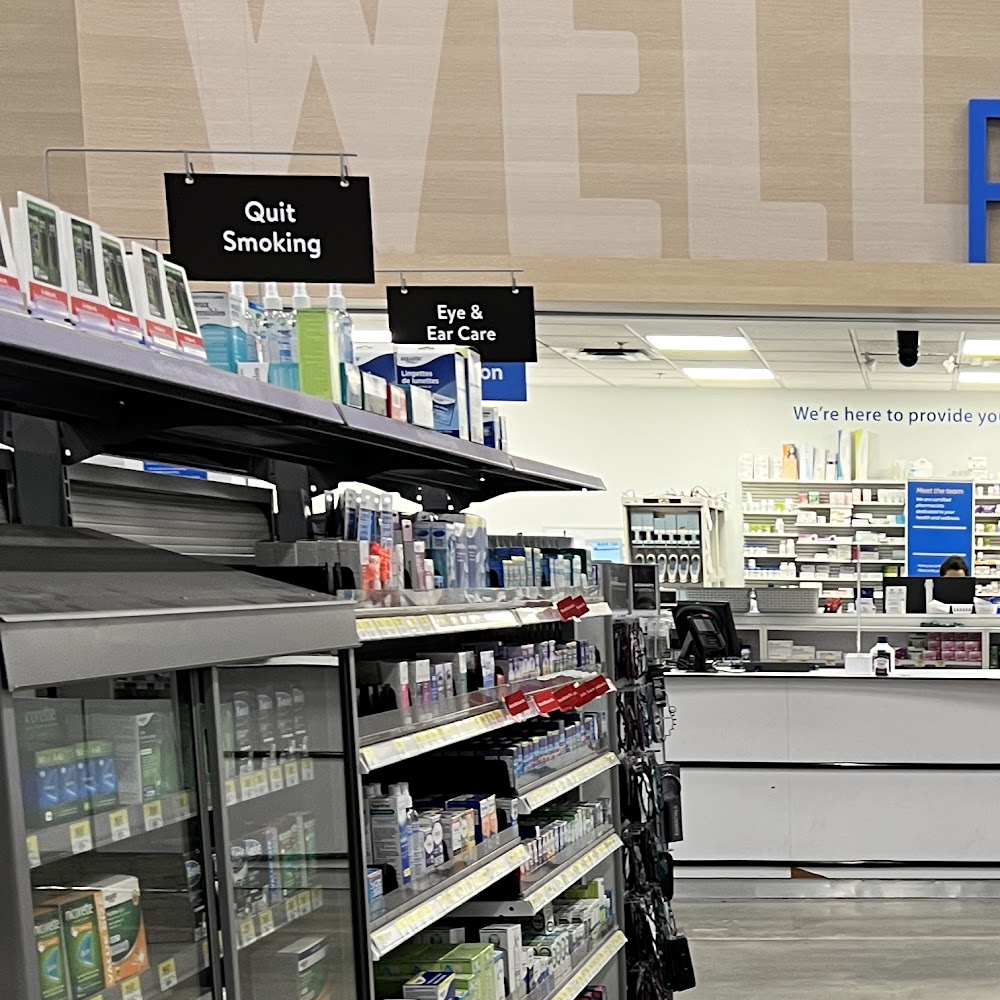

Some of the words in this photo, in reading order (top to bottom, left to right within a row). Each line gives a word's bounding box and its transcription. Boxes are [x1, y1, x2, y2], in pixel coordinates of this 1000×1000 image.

[244, 200, 297, 224] Quit
[222, 230, 322, 259] Smoking
[437, 304, 466, 324] Eye
[471, 304, 484, 320] &
[427, 326, 452, 341] Ear
[457, 326, 497, 341] Care
[793, 406, 839, 421] We're
[844, 406, 882, 421] here
[887, 409, 904, 422] to
[908, 408, 973, 425] provide
